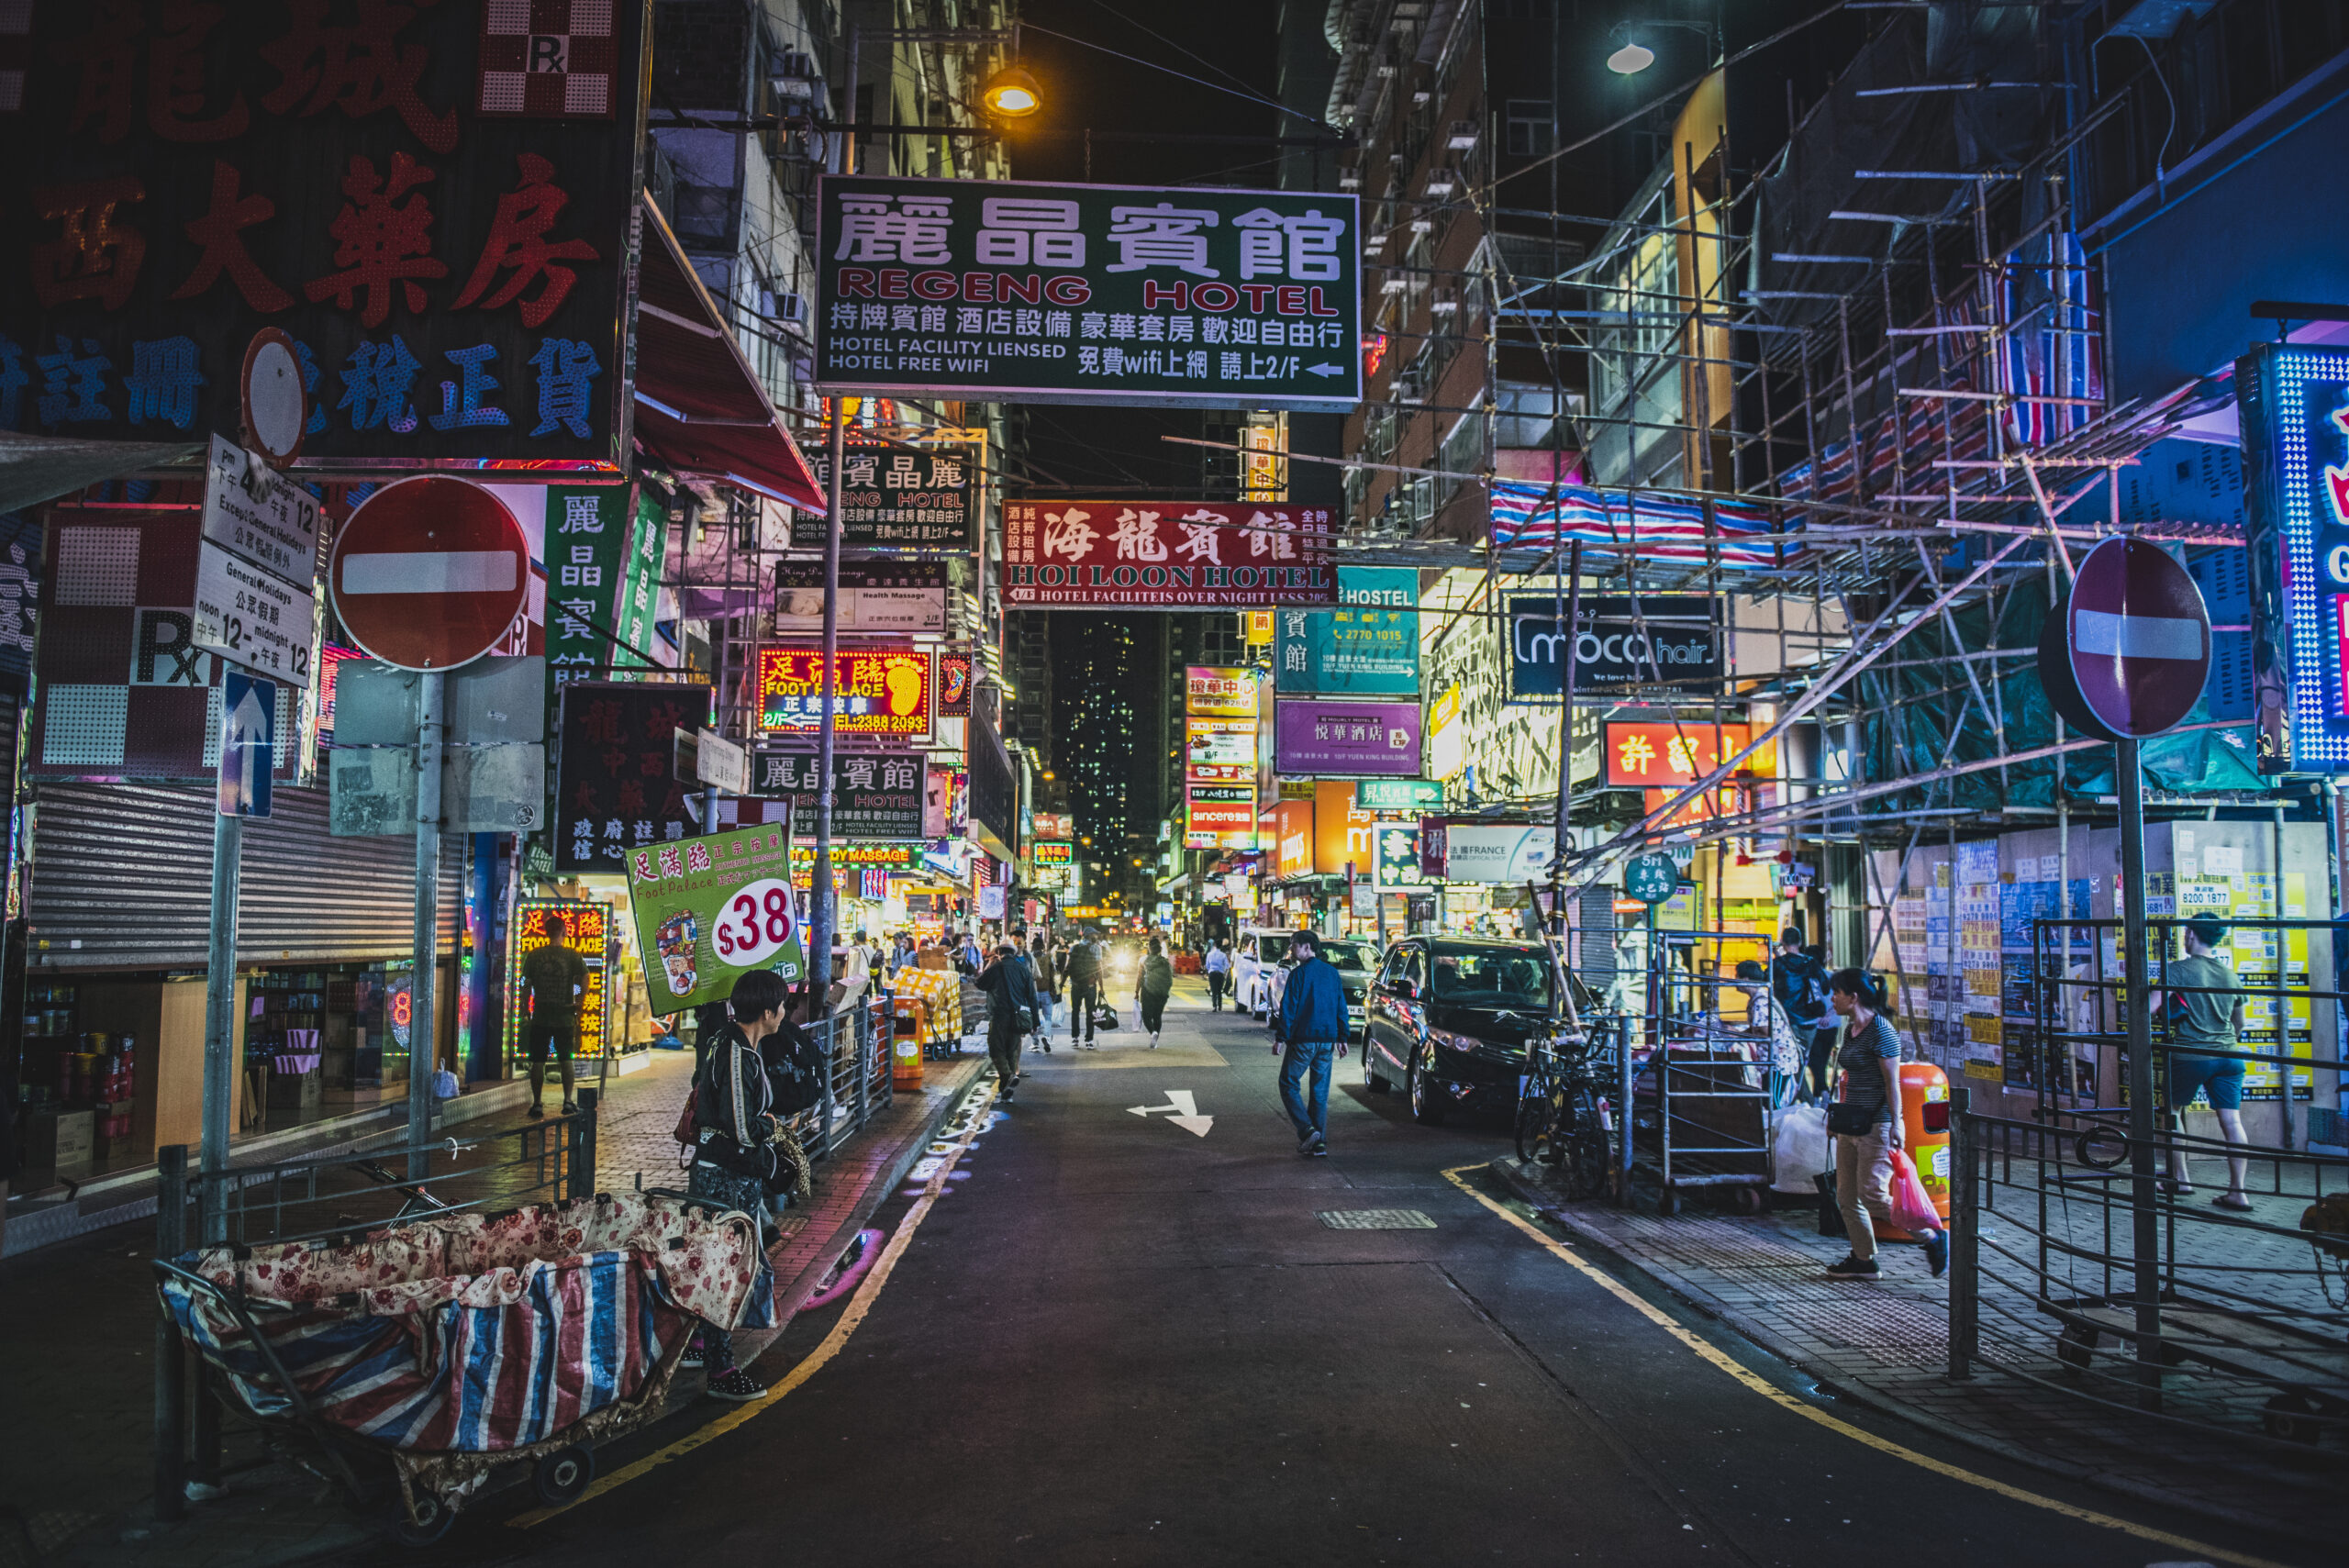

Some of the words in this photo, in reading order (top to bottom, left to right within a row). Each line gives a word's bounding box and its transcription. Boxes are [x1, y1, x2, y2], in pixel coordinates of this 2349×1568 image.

[834, 192, 1346, 281] 麗晶賓館
[837, 268, 1092, 306] REGENG
[1143, 280, 1340, 317] HOTEL
[830, 303, 948, 334] 持牌賓館
[955, 306, 1072, 339] 酒店設備
[1081, 311, 1196, 344] 豪華套房
[1202, 316, 1344, 350] 歡迎自由行
[829, 337, 894, 354] HOTEL
[899, 339, 982, 356] FACILITY
[988, 341, 1066, 359] LIENSED
[829, 354, 894, 370] HOTEL
[899, 356, 944, 372] FREE
[948, 357, 989, 373] WIFI
[1078, 346, 1208, 380] 免費wifi上網
[1220, 351, 1301, 383] 請上2/F
[222, 449, 236, 465] pm
[217, 465, 237, 493] 下午
[270, 500, 289, 523] 午夜
[296, 501, 314, 534] 12
[898, 492, 964, 508] HOTEL
[219, 495, 249, 522] Except
[249, 511, 277, 539] General
[277, 526, 306, 555] Holidays
[1008, 506, 1020, 562] 酒店設備
[1022, 507, 1036, 563] 純粹租房
[1043, 506, 1297, 566] 海龍賓館
[227, 562, 258, 586] General
[1008, 564, 1081, 586] HOI
[1089, 565, 1196, 588] LOON
[1203, 566, 1330, 588] HOTEL
[891, 593, 925, 601] Massage
[1041, 590, 1090, 602] HOTEL
[1094, 591, 1174, 603] FACILITEIS
[1177, 592, 1217, 603] OVER
[1219, 592, 1267, 604] NIGHT
[1347, 589, 1413, 607] HOSTEL
[236, 591, 280, 626] 公眾假期
[199, 599, 219, 618] noon
[254, 625, 288, 649] midnight
[1346, 630, 1372, 639] 2770
[1376, 630, 1401, 640] 1015
[197, 620, 217, 643] 中午
[261, 648, 280, 670] 午夜
[290, 642, 308, 677] 12
[1655, 639, 1708, 664] hair
[1594, 673, 1606, 682] We
[1608, 673, 1625, 682] love
[765, 682, 811, 696] FOOT
[891, 716, 923, 729] 2093
[1315, 724, 1384, 741] 悅華酒店
[854, 794, 919, 809] HOTEL
[713, 834, 780, 860] 正宗按摩
[751, 851, 782, 864] MASSAGE
[848, 851, 909, 862] MASSAGE
[1470, 846, 1506, 855] FRANCE
[633, 841, 712, 885] 足滿臨
[1642, 854, 1662, 867] 5M
[637, 883, 666, 901] Foot
[668, 879, 714, 895] Palace
[2183, 893, 2203, 903] 8200
[2208, 893, 2226, 903] 1877
[718, 886, 791, 958] $38
